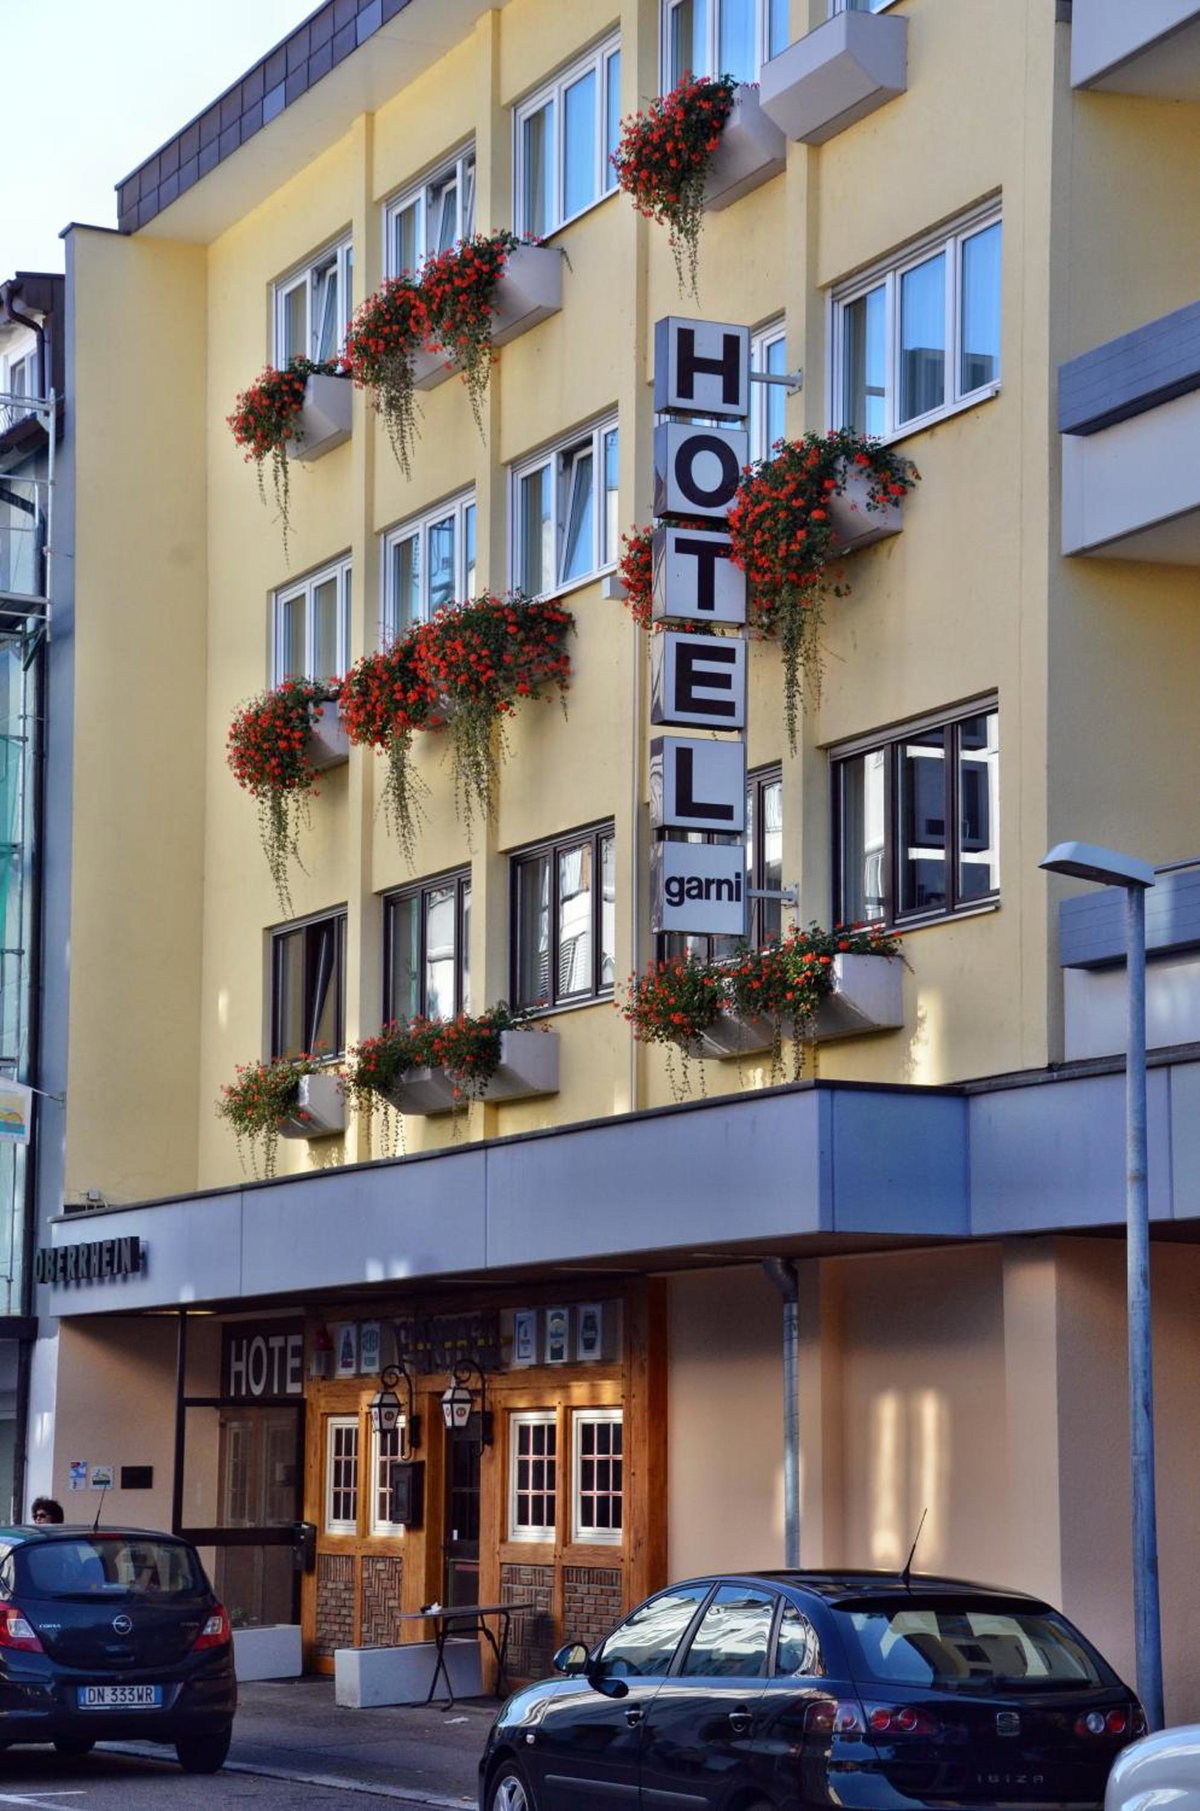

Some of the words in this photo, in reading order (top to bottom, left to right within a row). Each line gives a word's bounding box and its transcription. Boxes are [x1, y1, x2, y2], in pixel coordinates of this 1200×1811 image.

[674, 328, 741, 821] HOTEL
[664, 871, 742, 907] garni
[33, 1236, 139, 1283] OBERRHEIN
[87, 1687, 105, 1703] DN
[110, 1687, 153, 1703] 333WR
